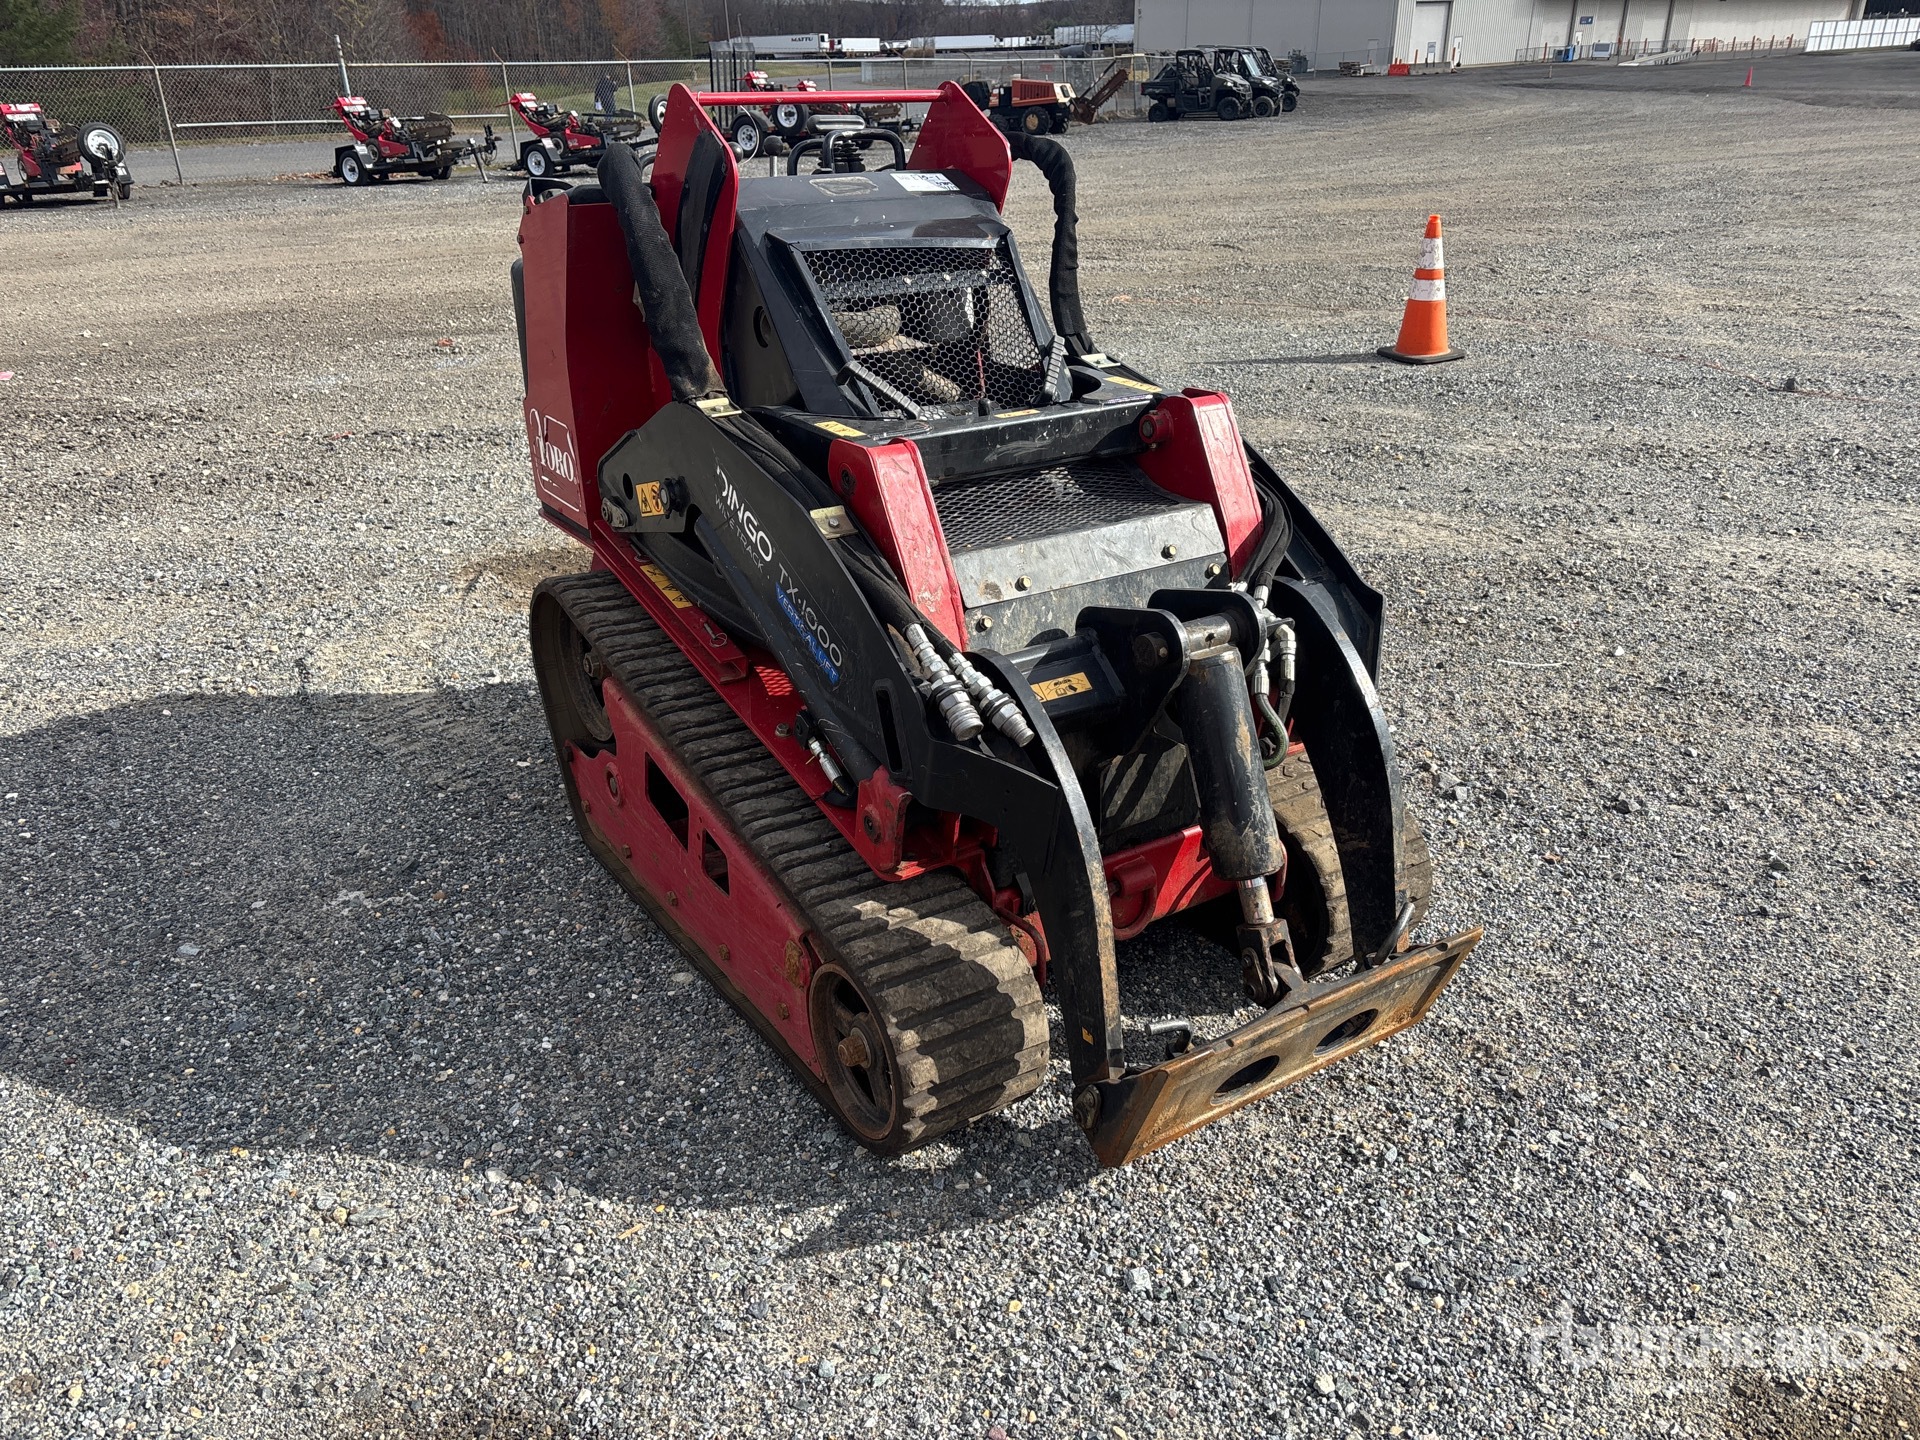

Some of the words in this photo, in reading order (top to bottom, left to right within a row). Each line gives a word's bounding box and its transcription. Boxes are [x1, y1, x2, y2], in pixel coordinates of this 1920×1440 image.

[530, 409, 574, 482] TORO
[735, 525, 764, 573] TRACK
[819, 651, 837, 679] LIFT
